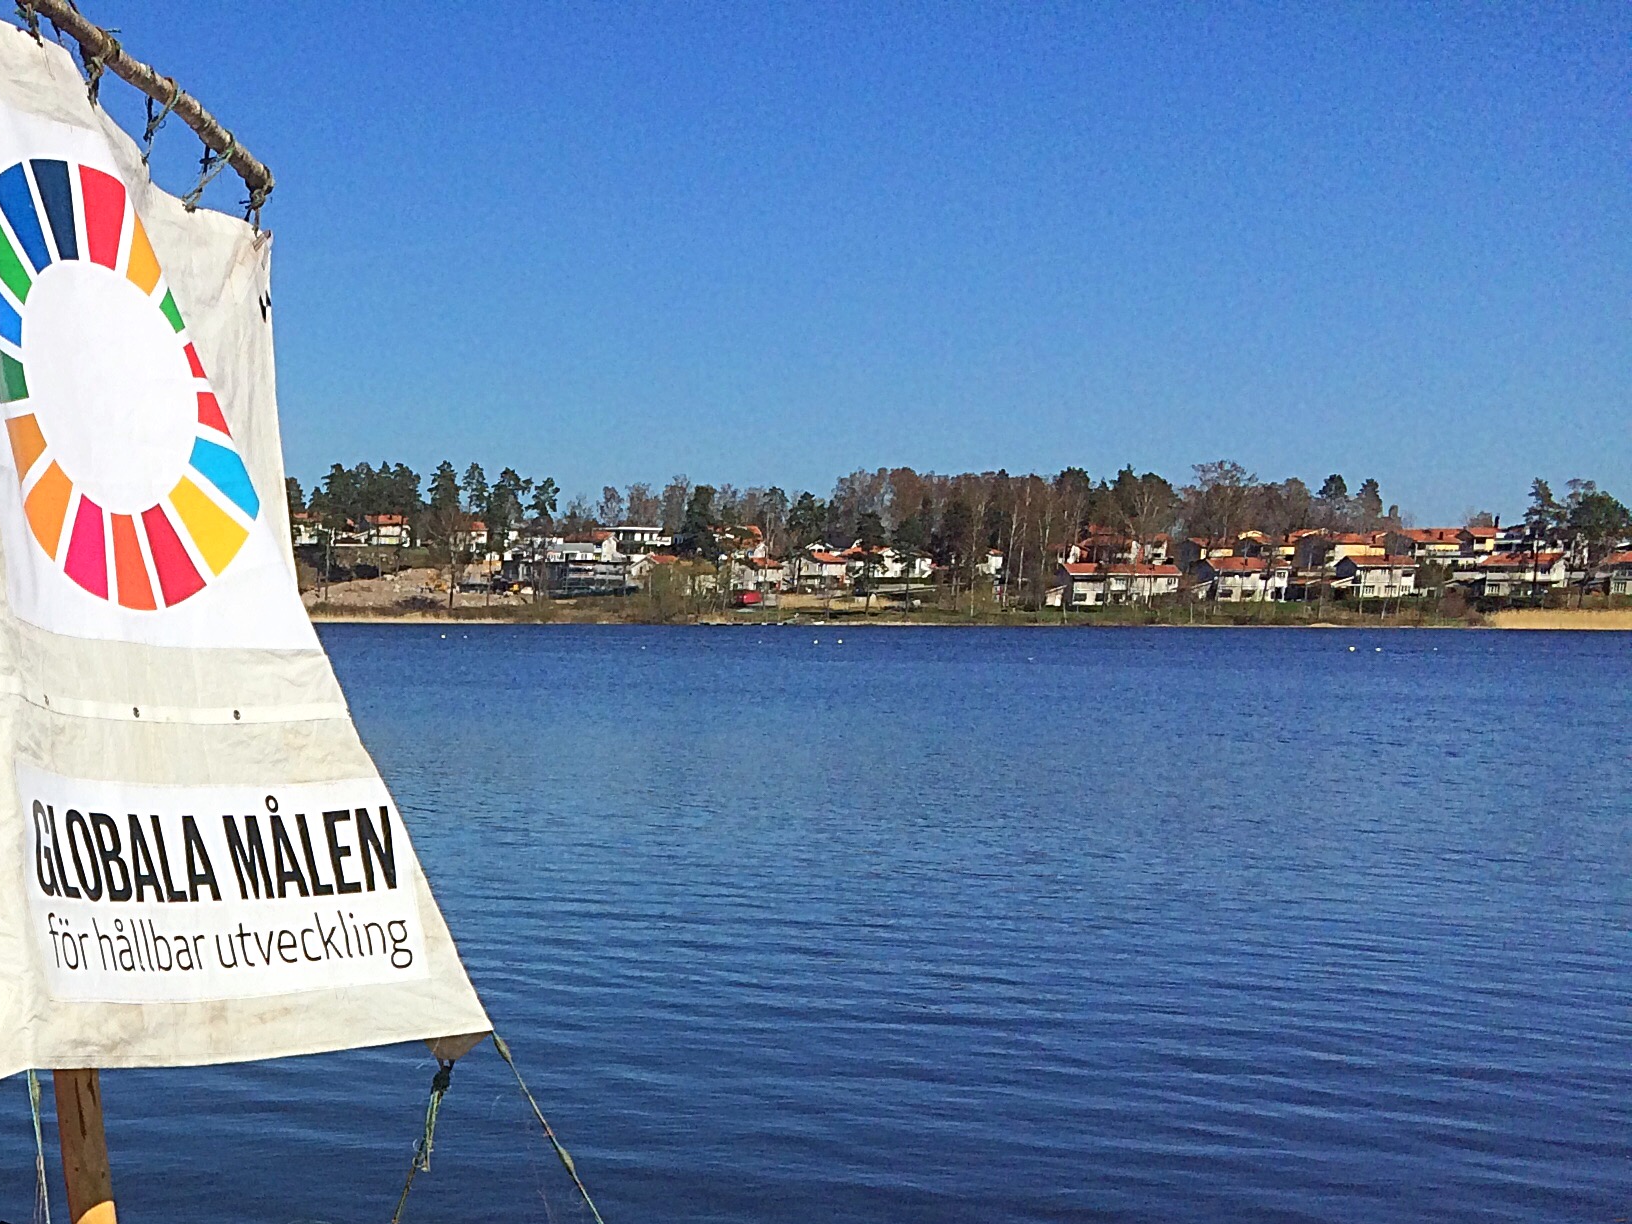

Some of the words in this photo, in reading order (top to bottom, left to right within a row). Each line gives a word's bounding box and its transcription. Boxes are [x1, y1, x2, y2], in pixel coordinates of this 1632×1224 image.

[32, 798, 221, 902] GLOBALA
[223, 795, 398, 900] MÅLEN
[48, 911, 90, 971] för
[92, 915, 206, 973] hållbar
[215, 910, 414, 969] utveckling
